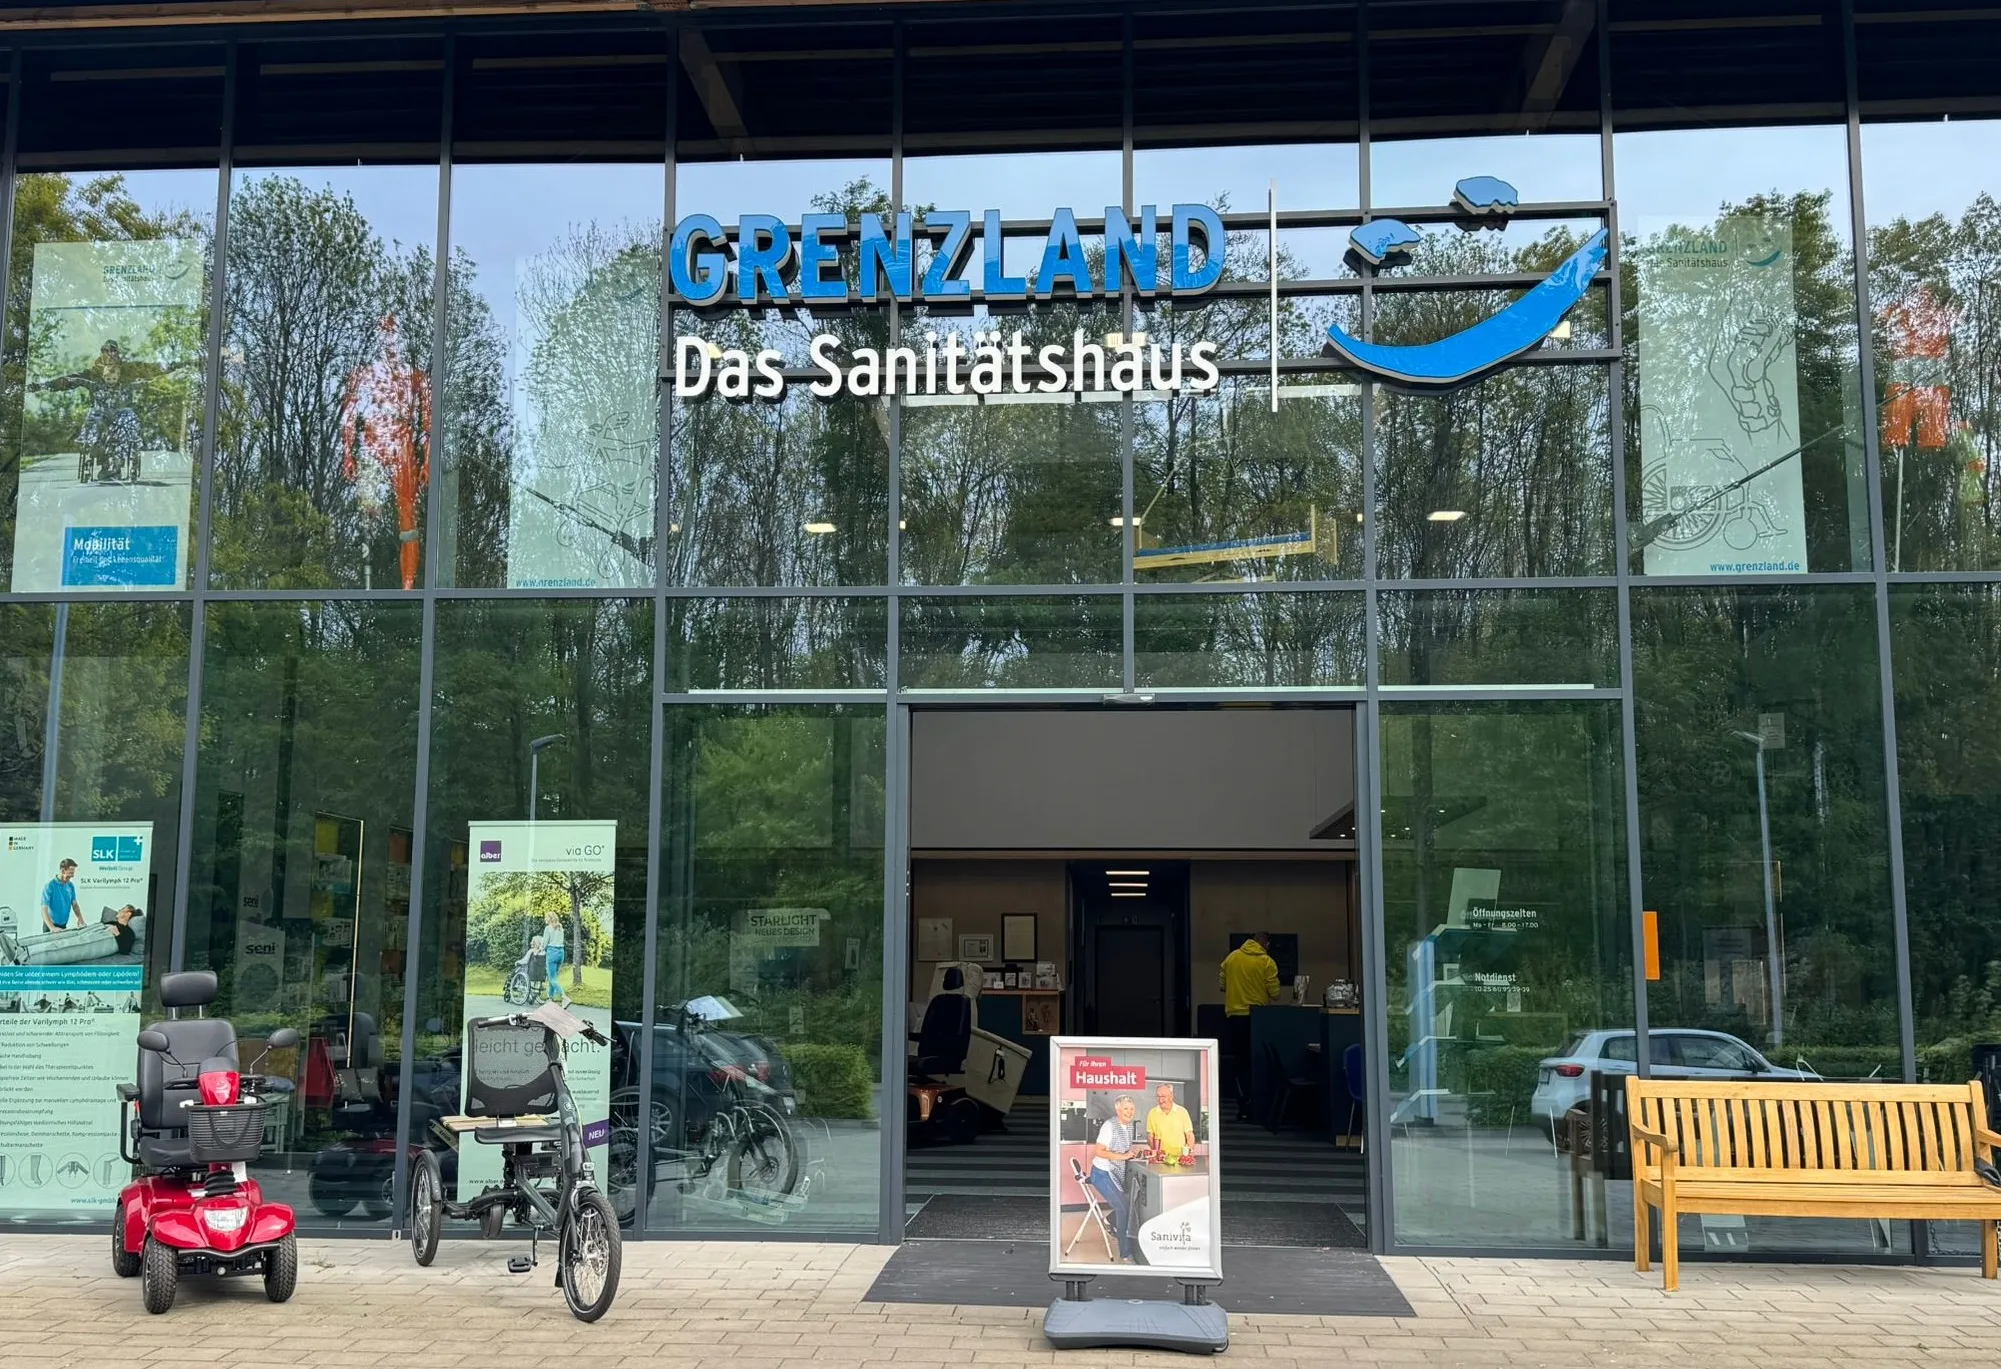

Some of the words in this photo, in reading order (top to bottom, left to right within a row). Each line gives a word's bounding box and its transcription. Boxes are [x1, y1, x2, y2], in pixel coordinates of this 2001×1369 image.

[670, 203, 1226, 302] GRENZLAND
[675, 336, 784, 398] Das
[809, 330, 1220, 397] Sanitätshaus
[73, 537, 130, 551] Mobilität
[1709, 561, 1800, 573] www.grenzland.de
[92, 849, 115, 859] SLK
[480, 851, 501, 859] alber
[566, 845, 581, 856] via
[1472, 907, 1537, 919] Öffnungszeiten
[751, 914, 817, 926] STARLIGHT
[755, 928, 783, 936] NEUES
[245, 942, 276, 954] seni
[1475, 972, 1517, 981] Notdienst
[475, 1038, 518, 1053] leicht
[523, 1038, 601, 1057] geacht.
[1090, 1060, 1107, 1068] Ihren
[1076, 1070, 1137, 1085] Haushalt
[589, 1128, 605, 1140] NEU
[1150, 1229, 1192, 1245] Sanivita
